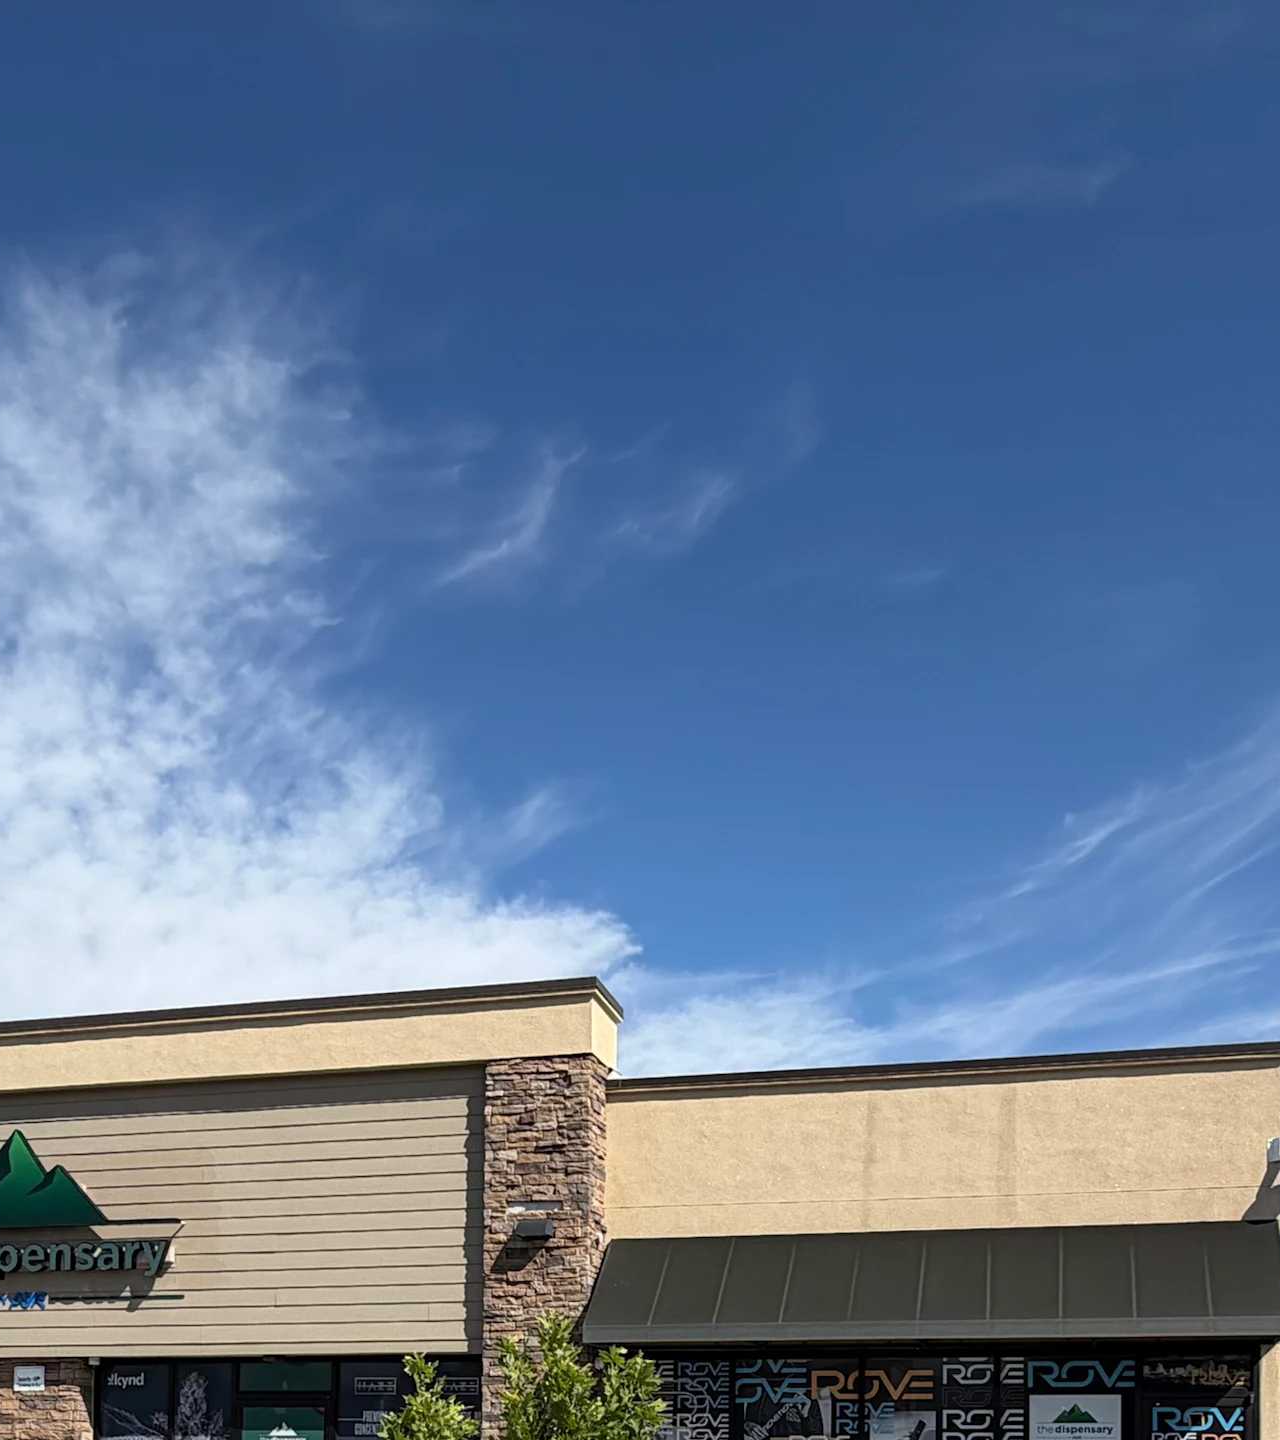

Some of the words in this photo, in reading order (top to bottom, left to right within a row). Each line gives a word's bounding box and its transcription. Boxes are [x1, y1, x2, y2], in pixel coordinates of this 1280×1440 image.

[677, 1362, 730, 1376] ROVE
[1027, 1360, 1136, 1388] ROVE
[114, 1372, 145, 1389] kynd
[677, 1378, 730, 1391] ROVE
[811, 1370, 934, 1400] ROVE
[735, 1378, 808, 1403] OVE
[677, 1395, 730, 1409] ROVE
[836, 1402, 895, 1418] ROVE
[676, 1413, 729, 1428] ROVE
[1037, 1425, 1054, 1434] the
[1055, 1425, 1113, 1435] dispensary
